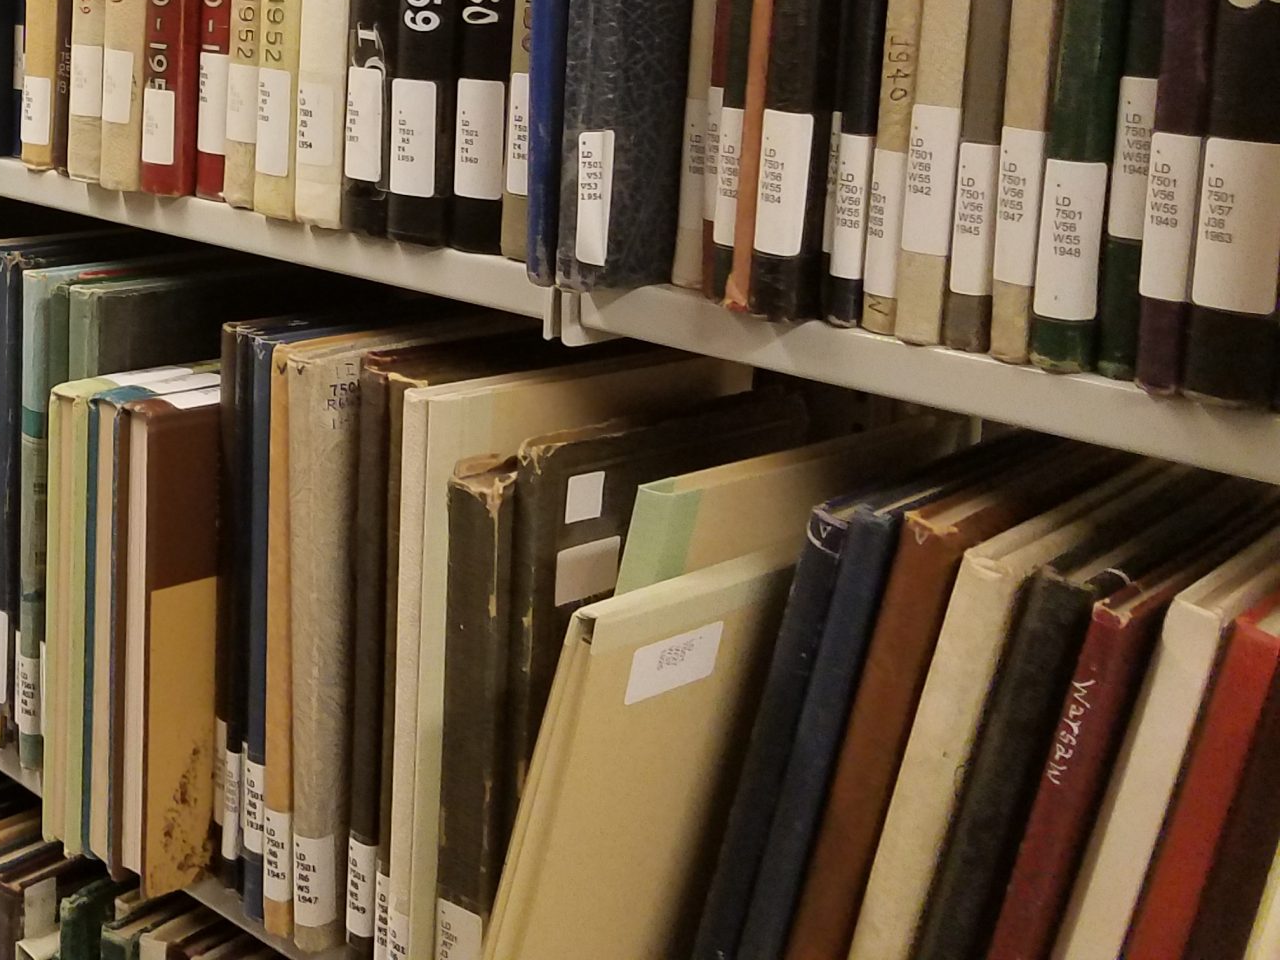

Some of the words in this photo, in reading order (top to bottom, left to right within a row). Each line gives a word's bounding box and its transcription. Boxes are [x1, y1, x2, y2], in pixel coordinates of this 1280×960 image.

[886, 35, 911, 102] 1940
[1154, 163, 1171, 174] LD
[1151, 174, 1177, 188] 7501
[1055, 196, 1072, 207] LD
[1149, 201, 1178, 215] W55
[1055, 207, 1083, 220] 7501
[1149, 215, 1178, 228] 1949
[868, 226, 884, 239] 940
[1053, 232, 1081, 246] W55
[1053, 245, 1082, 258] 1948
[1047, 679, 1097, 785] Warsaw
